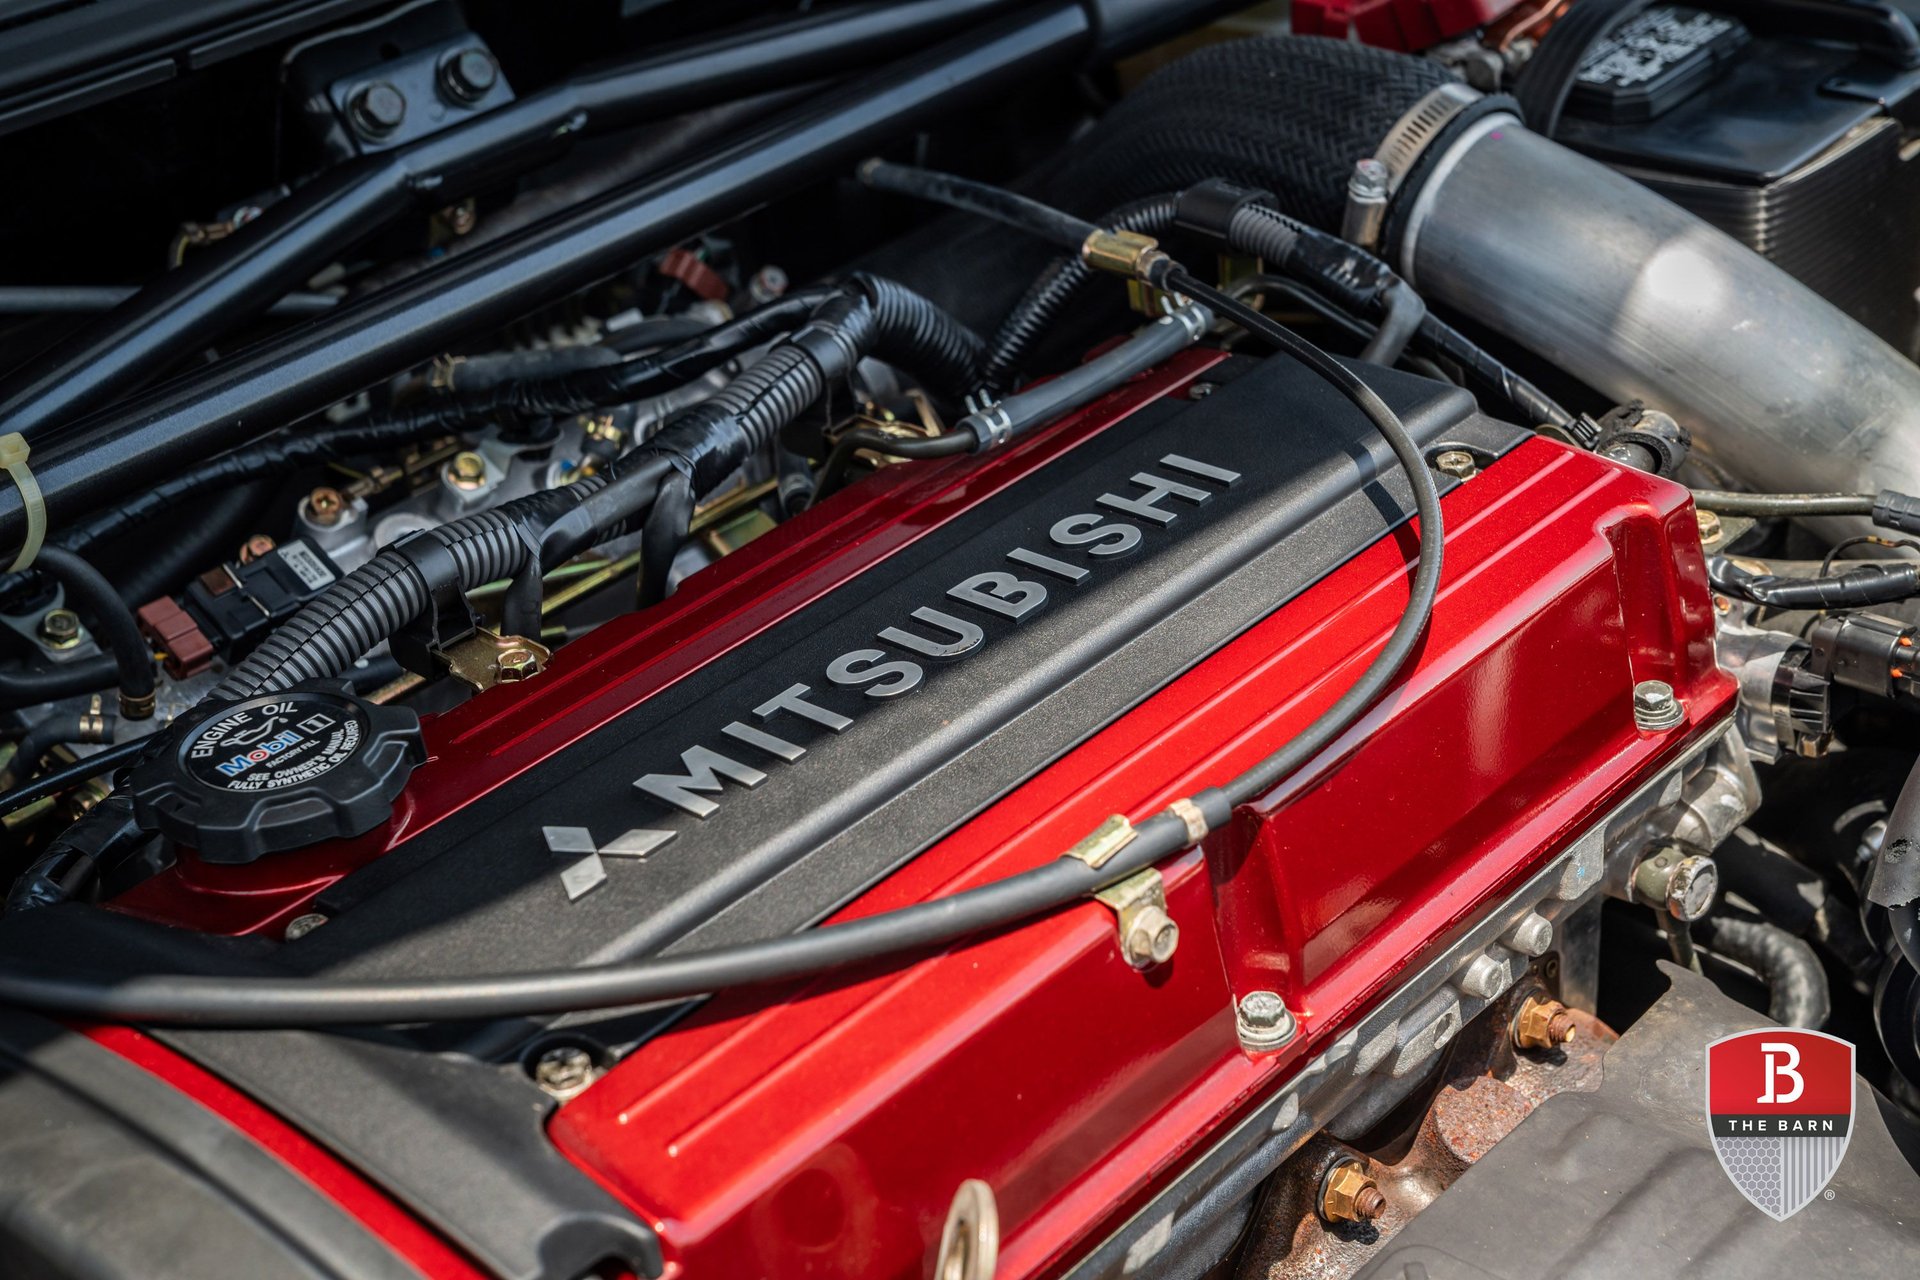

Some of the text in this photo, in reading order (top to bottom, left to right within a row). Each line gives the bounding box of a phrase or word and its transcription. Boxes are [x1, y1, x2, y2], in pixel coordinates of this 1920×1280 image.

[633, 453, 1242, 819] MITSUBISHI
[191, 702, 298, 758] ENGINE OIL
[216, 730, 304, 777] Mobil
[228, 720, 360, 790] FULLY SYNTHETIC OIL REQUIRED
[247, 729, 344, 781] SEE OWNER'S MANUAL
[266, 739, 320, 768] FACTORY FILL
